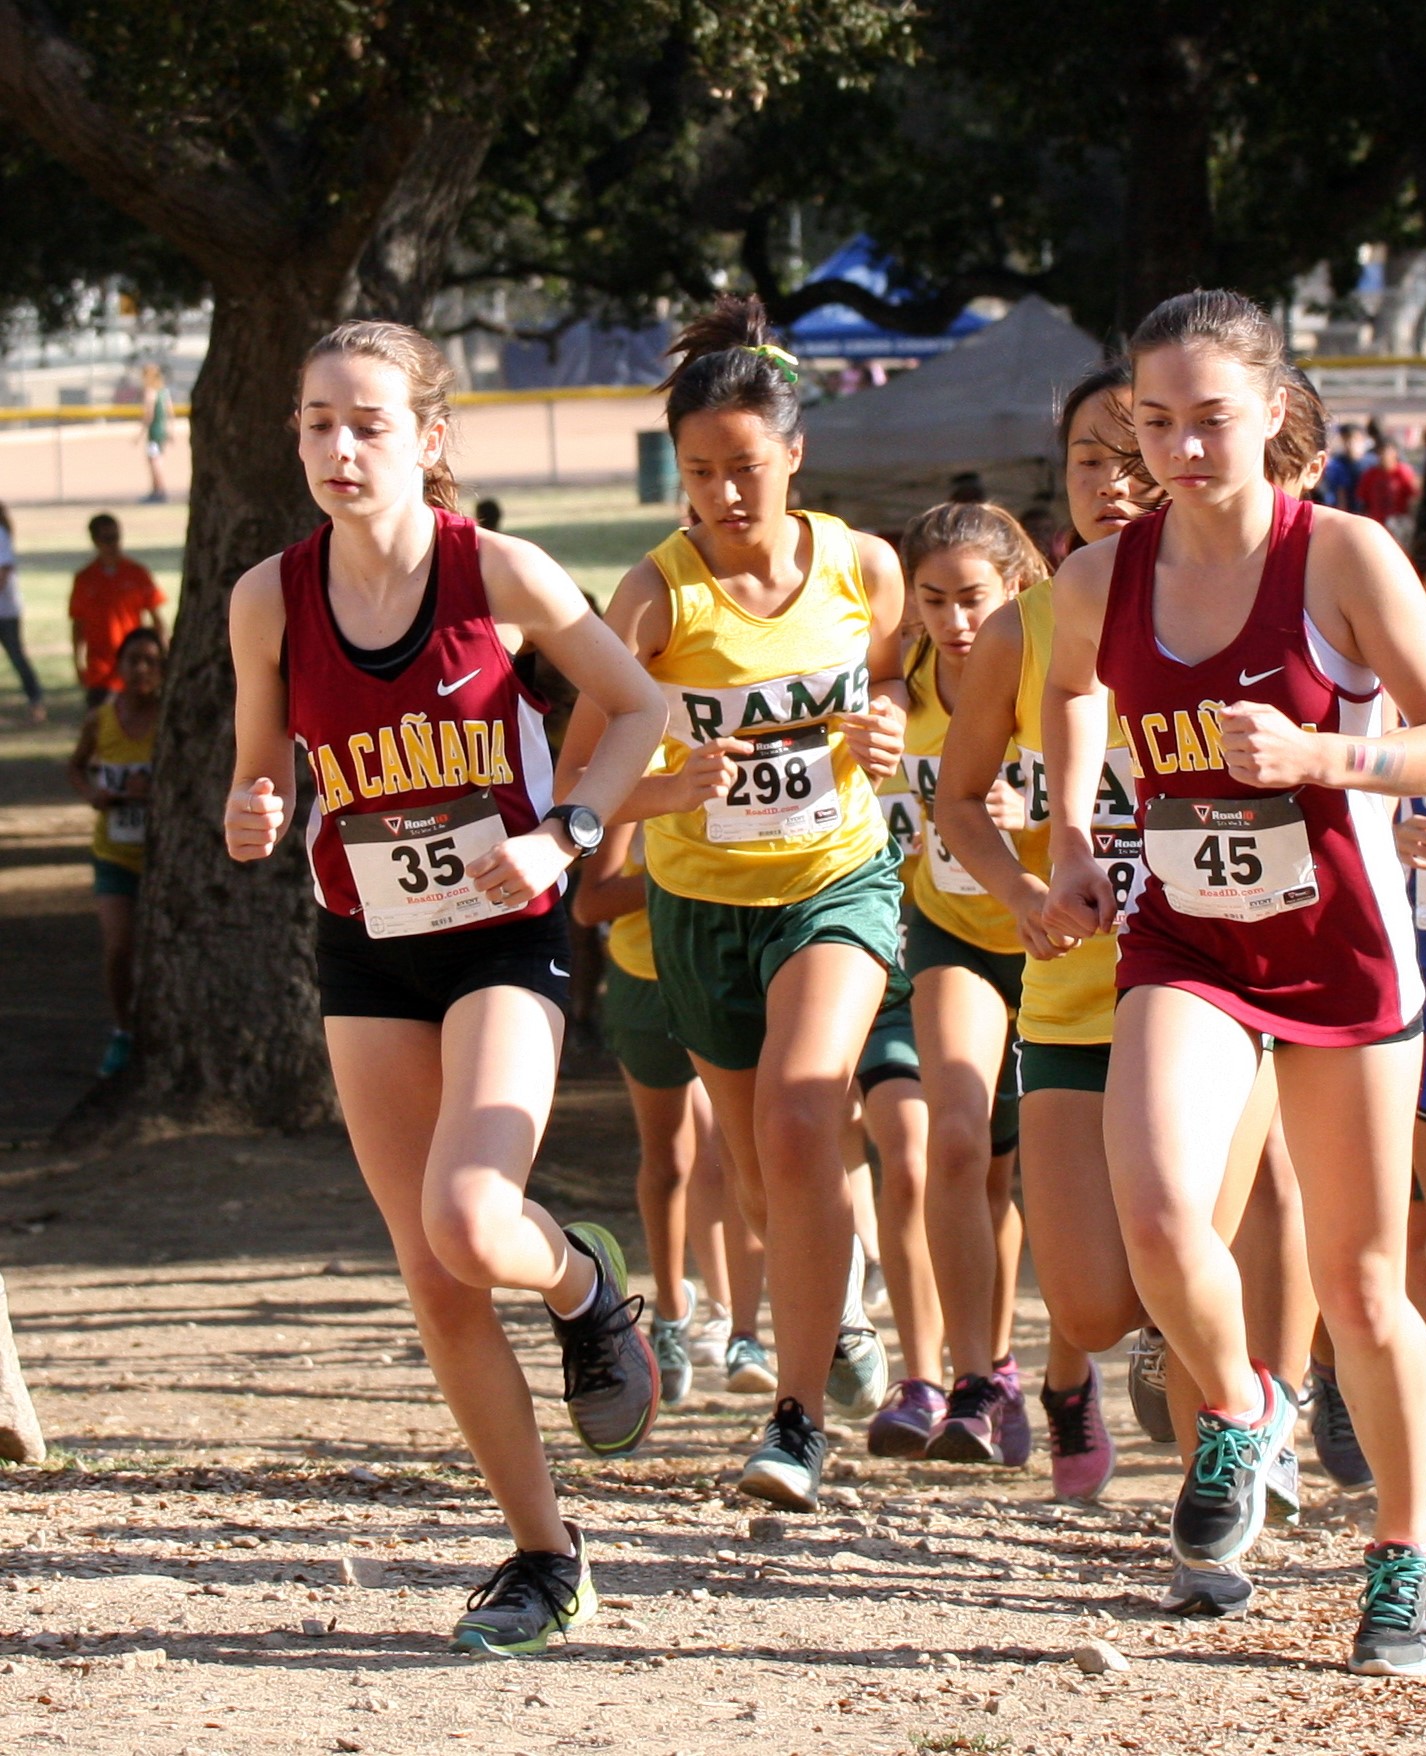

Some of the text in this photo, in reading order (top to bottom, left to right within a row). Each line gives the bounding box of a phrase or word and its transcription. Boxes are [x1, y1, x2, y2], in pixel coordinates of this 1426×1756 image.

[682, 660, 868, 744] RAMS
[348, 712, 514, 798] CAÑADA
[727, 757, 811, 806] 298
[1211, 810, 1255, 821] RoadID
[391, 837, 465, 894] 35
[1193, 835, 1263, 886] 45
[1199, 887, 1265, 898] RoadID.com
